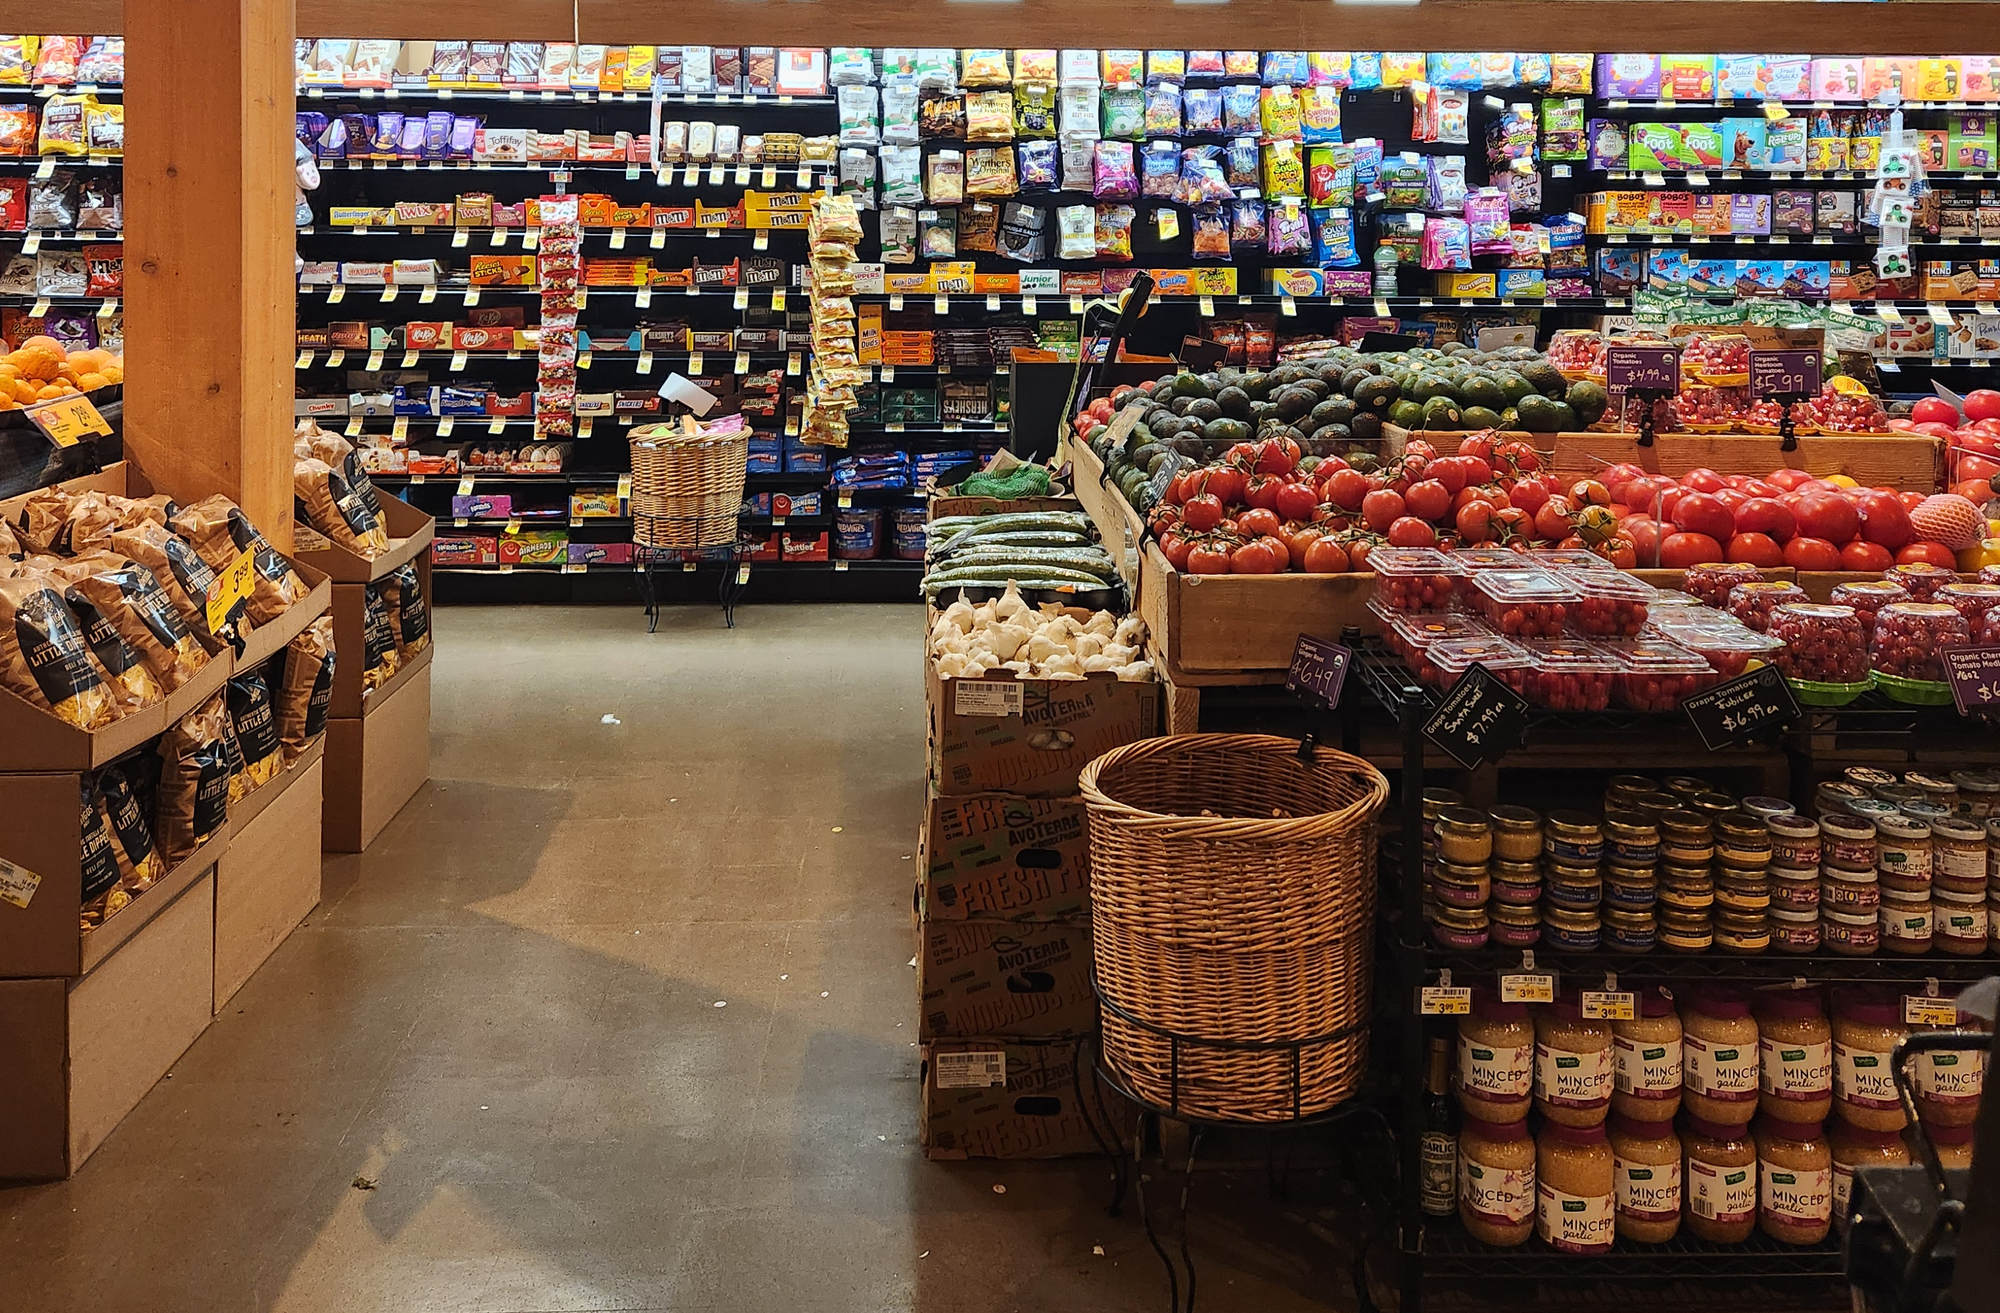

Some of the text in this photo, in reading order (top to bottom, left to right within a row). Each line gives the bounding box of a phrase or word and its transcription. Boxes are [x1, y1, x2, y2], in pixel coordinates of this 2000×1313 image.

[1306, 109, 1338, 120] Swedish
[1315, 115, 1333, 124] Fish
[489, 135, 523, 147] Toffifay
[971, 157, 1011, 168] Werther's
[979, 166, 1009, 174] Original
[1335, 169, 1352, 177] AIR
[1275, 172, 1299, 182] PATCH
[1324, 179, 1352, 190] HEADS
[334, 210, 369, 218] Butterfinger
[961, 212, 996, 222] Werther's
[969, 220, 993, 228] Original
[1322, 225, 1345, 234] JOLLY
[474, 267, 503, 278] STICKS
[1830, 267, 1850, 275] KIND
[1931, 267, 1951, 275] KIND
[1979, 266, 1999, 274] KIND
[43, 276, 87, 286] KISSES
[1021, 274, 1052, 283] Junior
[1286, 278, 1314, 290] Swedish
[1334, 279, 1365, 289] Spree
[1292, 285, 1309, 294] Fish
[1666, 300, 1685, 309] BASIL
[1699, 312, 1740, 324] YOUR BASIL
[1852, 317, 1866, 329] FOR
[298, 335, 327, 343] HEATH
[649, 332, 674, 340] HERSHEY'S
[695, 334, 720, 343] HERSHEY'S
[741, 332, 766, 340] HERSHEY'S
[862, 329, 878, 338] Milk
[861, 338, 879, 349] Duds
[1937, 330, 1948, 356] glutino
[1627, 369, 1660, 382] $4.99
[308, 402, 335, 411] Chunky
[584, 503, 609, 511] Mamba
[519, 542, 551, 556] AIRHEADS
[1301, 641, 1317, 652] Organic
[30, 644, 67, 667] LITTLE
[1299, 648, 1324, 663] Ginger Root
[1950, 653, 1980, 662] Organic
[1689, 678, 1758, 709] Grape Tomatoes
[1427, 683, 1472, 734] Grape Tomatoes
[1722, 704, 1765, 732] $6.99
[238, 715, 261, 733] LITTLE
[1466, 708, 1498, 744] $7.99
[1471, 1064, 1522, 1081] MINCED
[1473, 1076, 1501, 1089] garlic
[1557, 1074, 1606, 1088] MINCED
[1645, 1076, 1672, 1086] garlic
[1716, 1079, 1746, 1089] garlic
[1784, 1079, 1816, 1089] garlic
[1856, 1073, 1894, 1087] MINC
[1558, 1086, 1589, 1096] garlic
[1856, 1085, 1888, 1097] garlic
[1935, 1083, 1966, 1094] garlic
[1629, 1185, 1678, 1199] MINCED
[1772, 1188, 1825, 1206] MINCED
[1630, 1198, 1661, 1209] garlic
[1773, 1201, 1805, 1214] garlic
[1562, 1217, 1610, 1231] MINCED
[1563, 1231, 1593, 1240] garlic
